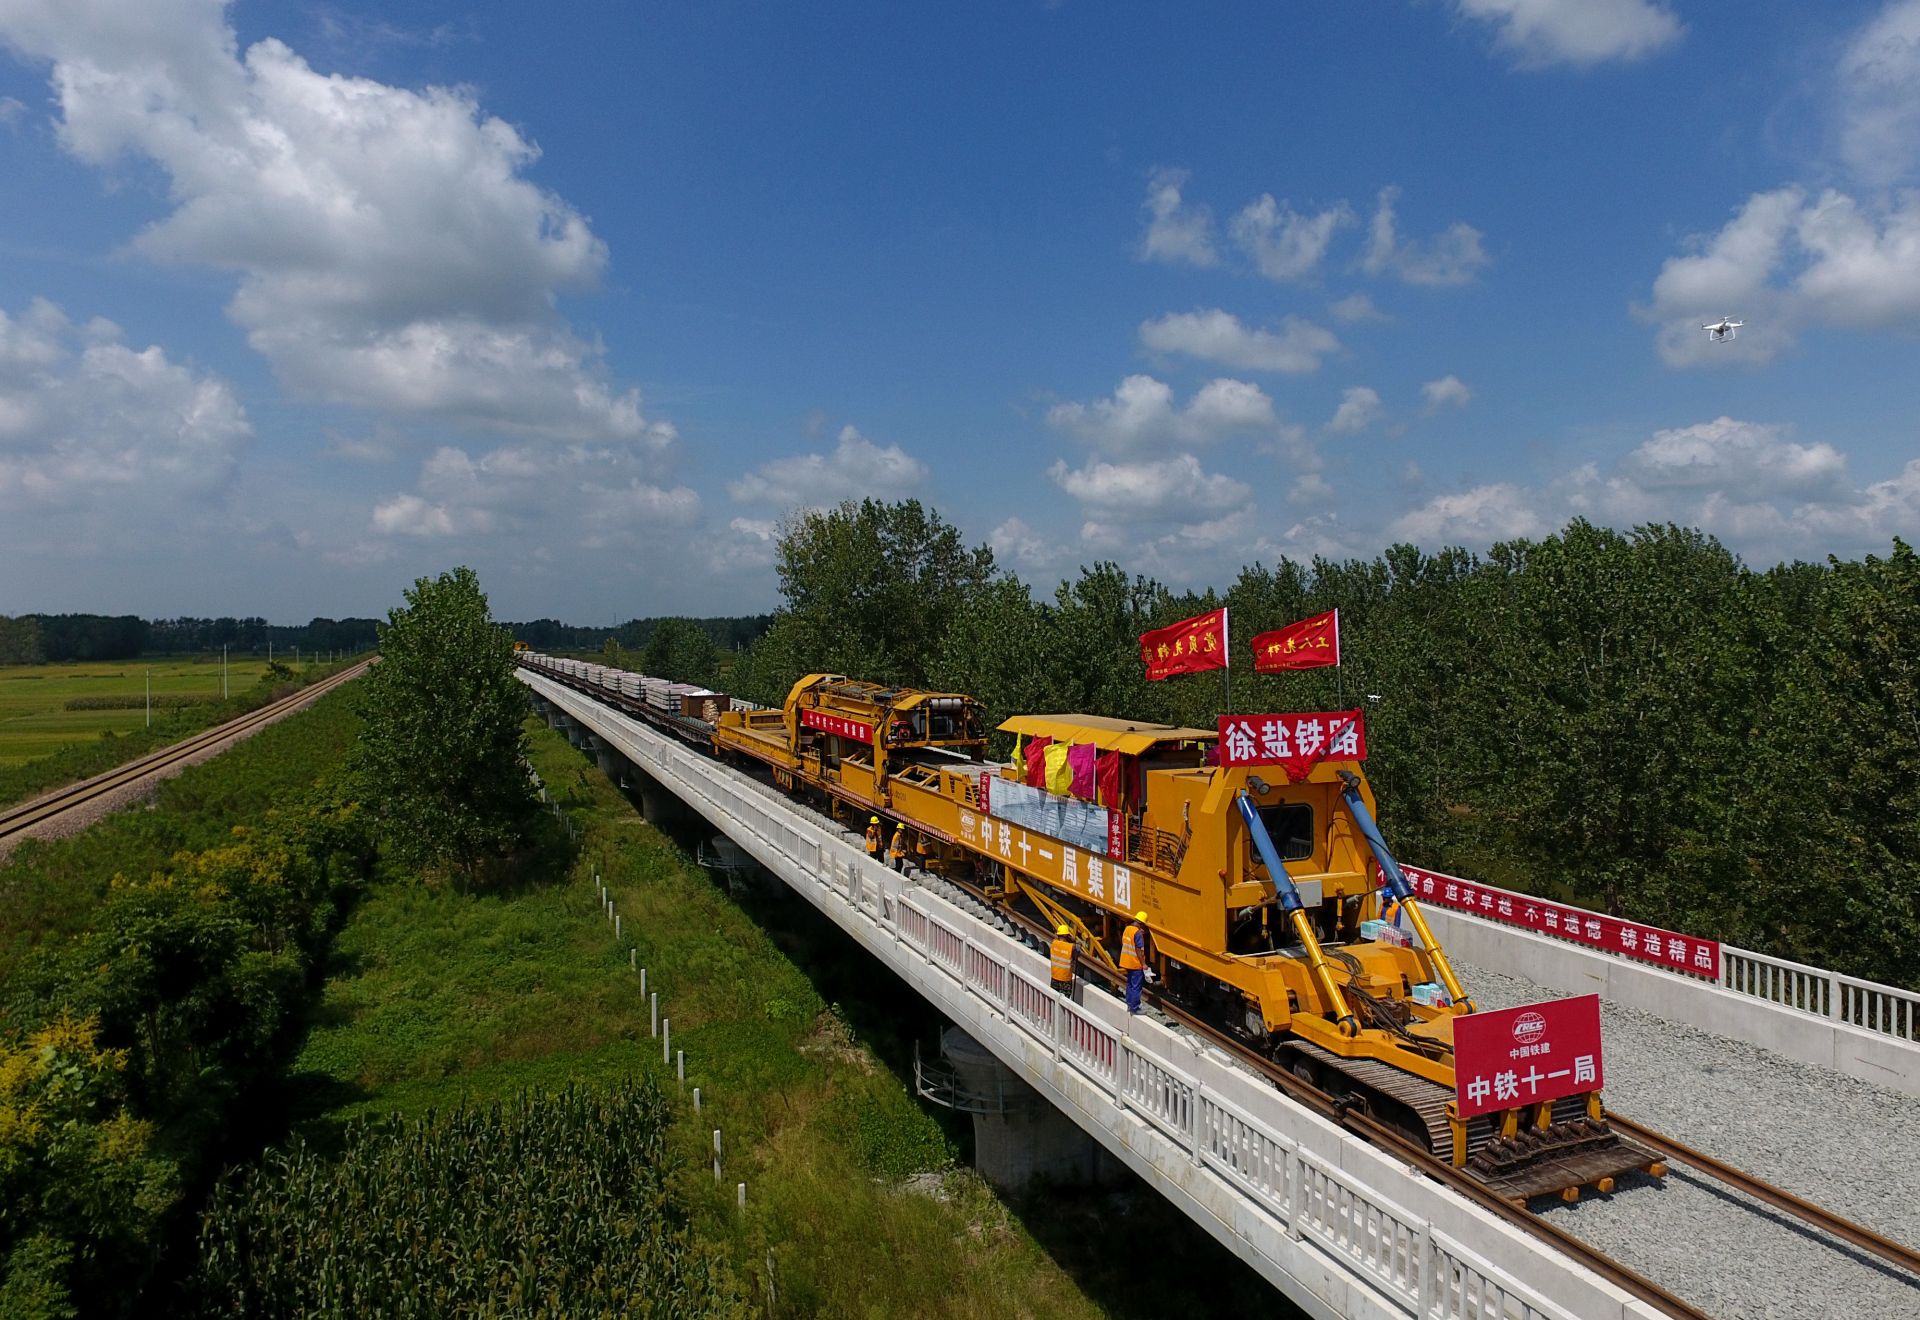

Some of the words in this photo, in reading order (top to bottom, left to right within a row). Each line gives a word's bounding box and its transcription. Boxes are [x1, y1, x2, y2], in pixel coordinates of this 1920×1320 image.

[1225, 718, 1359, 760] 徐盐铁路
[1110, 814, 1121, 858] 勇攀高峰
[982, 816, 1131, 909] 中铁十一局集团
[1377, 865, 1435, 895] 不使命
[1525, 903, 1602, 940] 不留遗憾
[1620, 926, 1713, 970] 铸造精品
[1514, 1021, 1545, 1035] CRCC
[1509, 1042, 1551, 1060] 中国铁建
[1467, 1054, 1596, 1106] 中铁十一局
